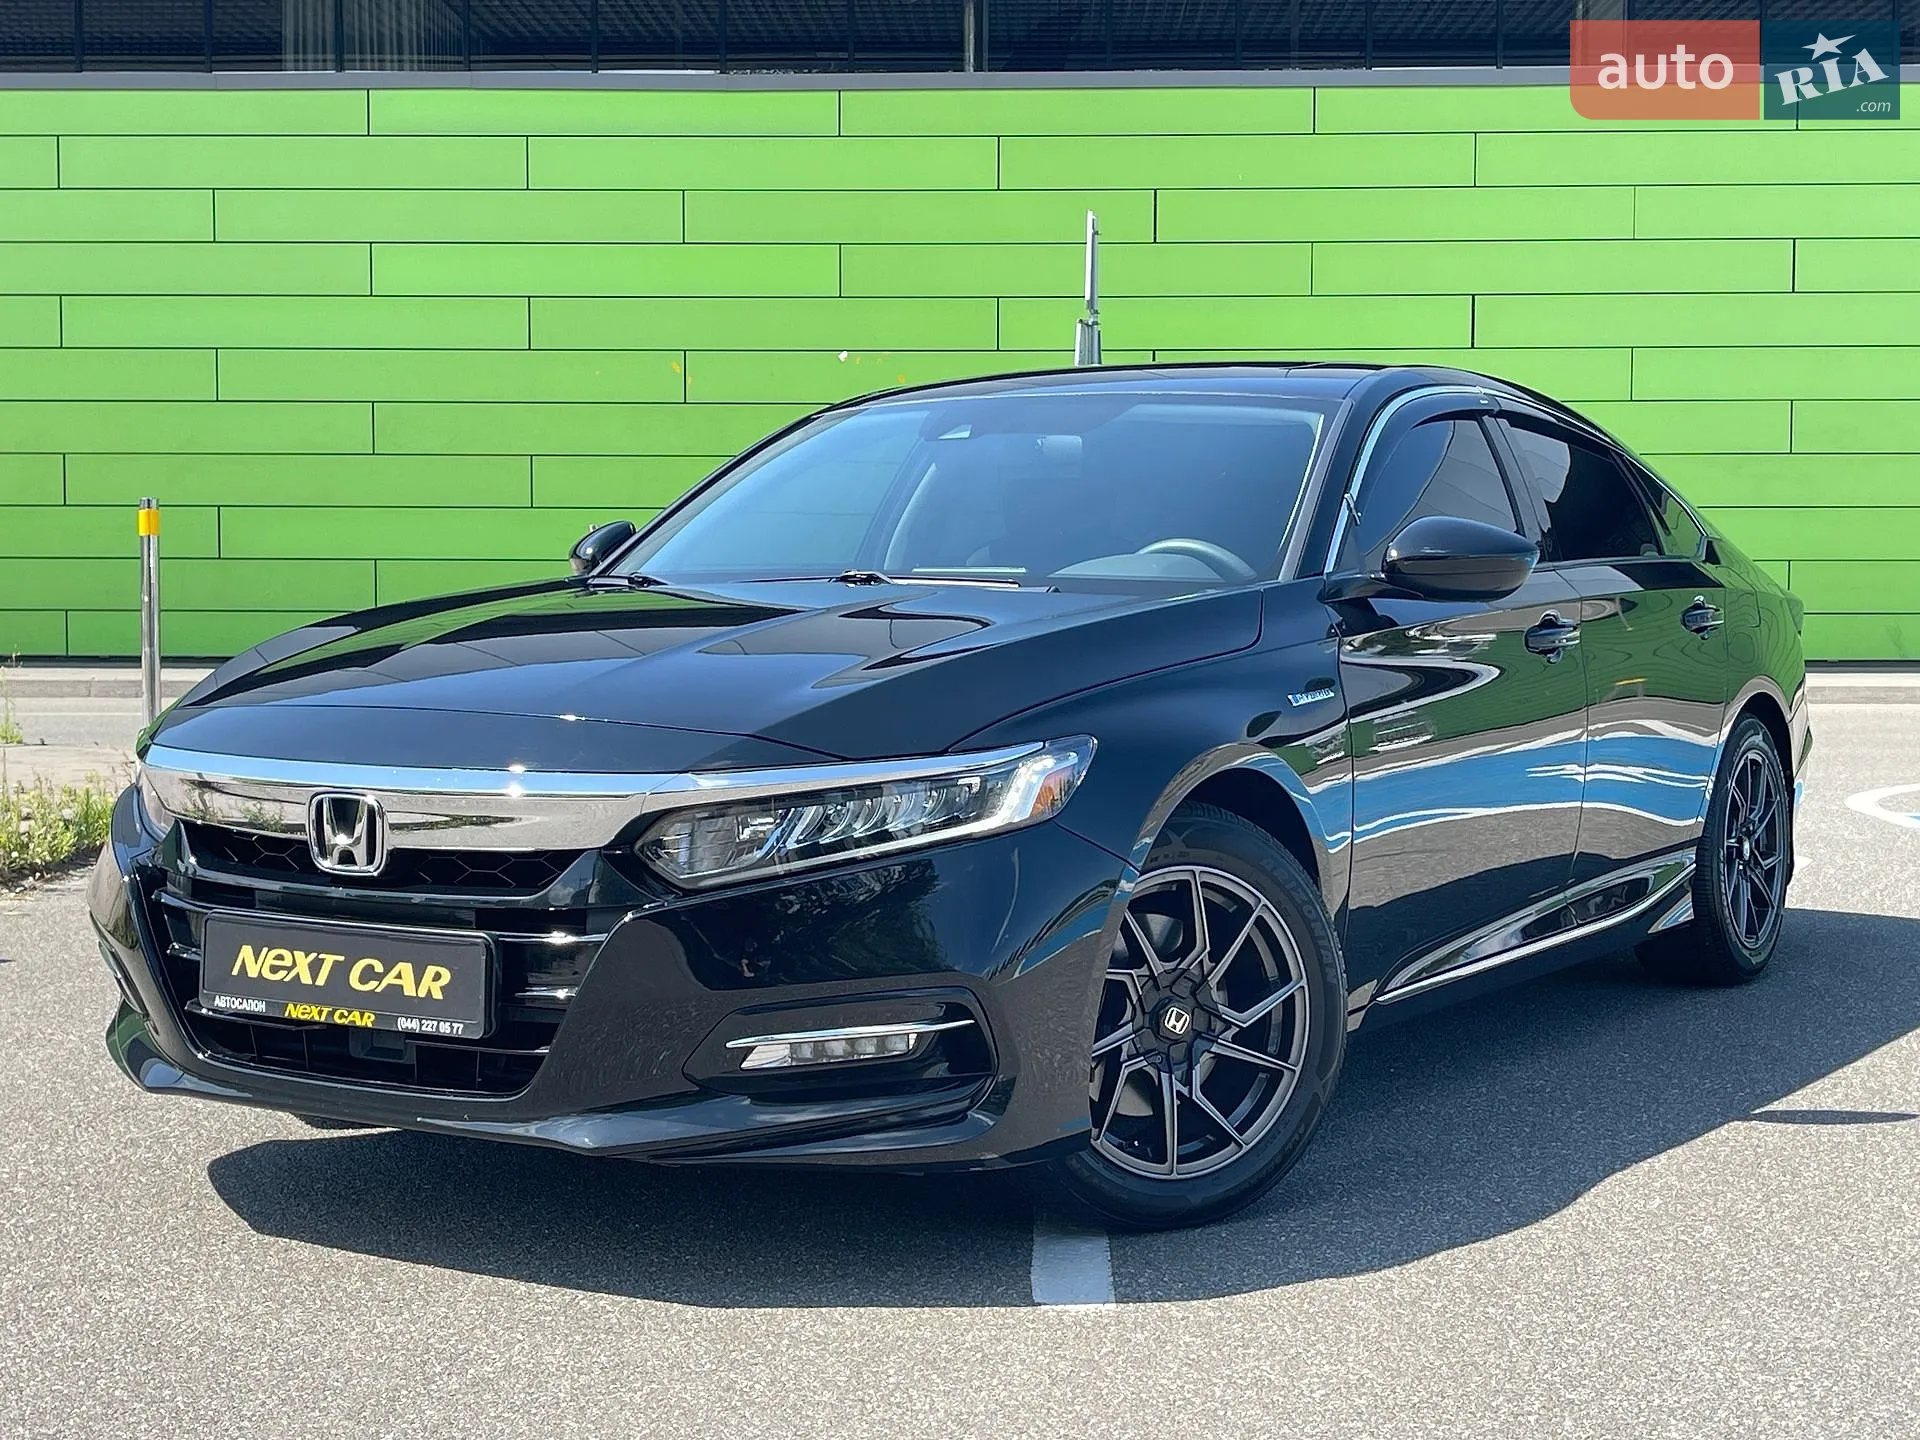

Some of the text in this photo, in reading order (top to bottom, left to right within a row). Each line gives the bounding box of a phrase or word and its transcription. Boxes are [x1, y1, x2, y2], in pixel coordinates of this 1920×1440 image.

[348, 957, 451, 1000] CAR
[214, 994, 266, 1013] АВТОСАЛОН
[333, 1008, 376, 1028] CAR
[397, 1016, 464, 1035] (044) 227 05 77
